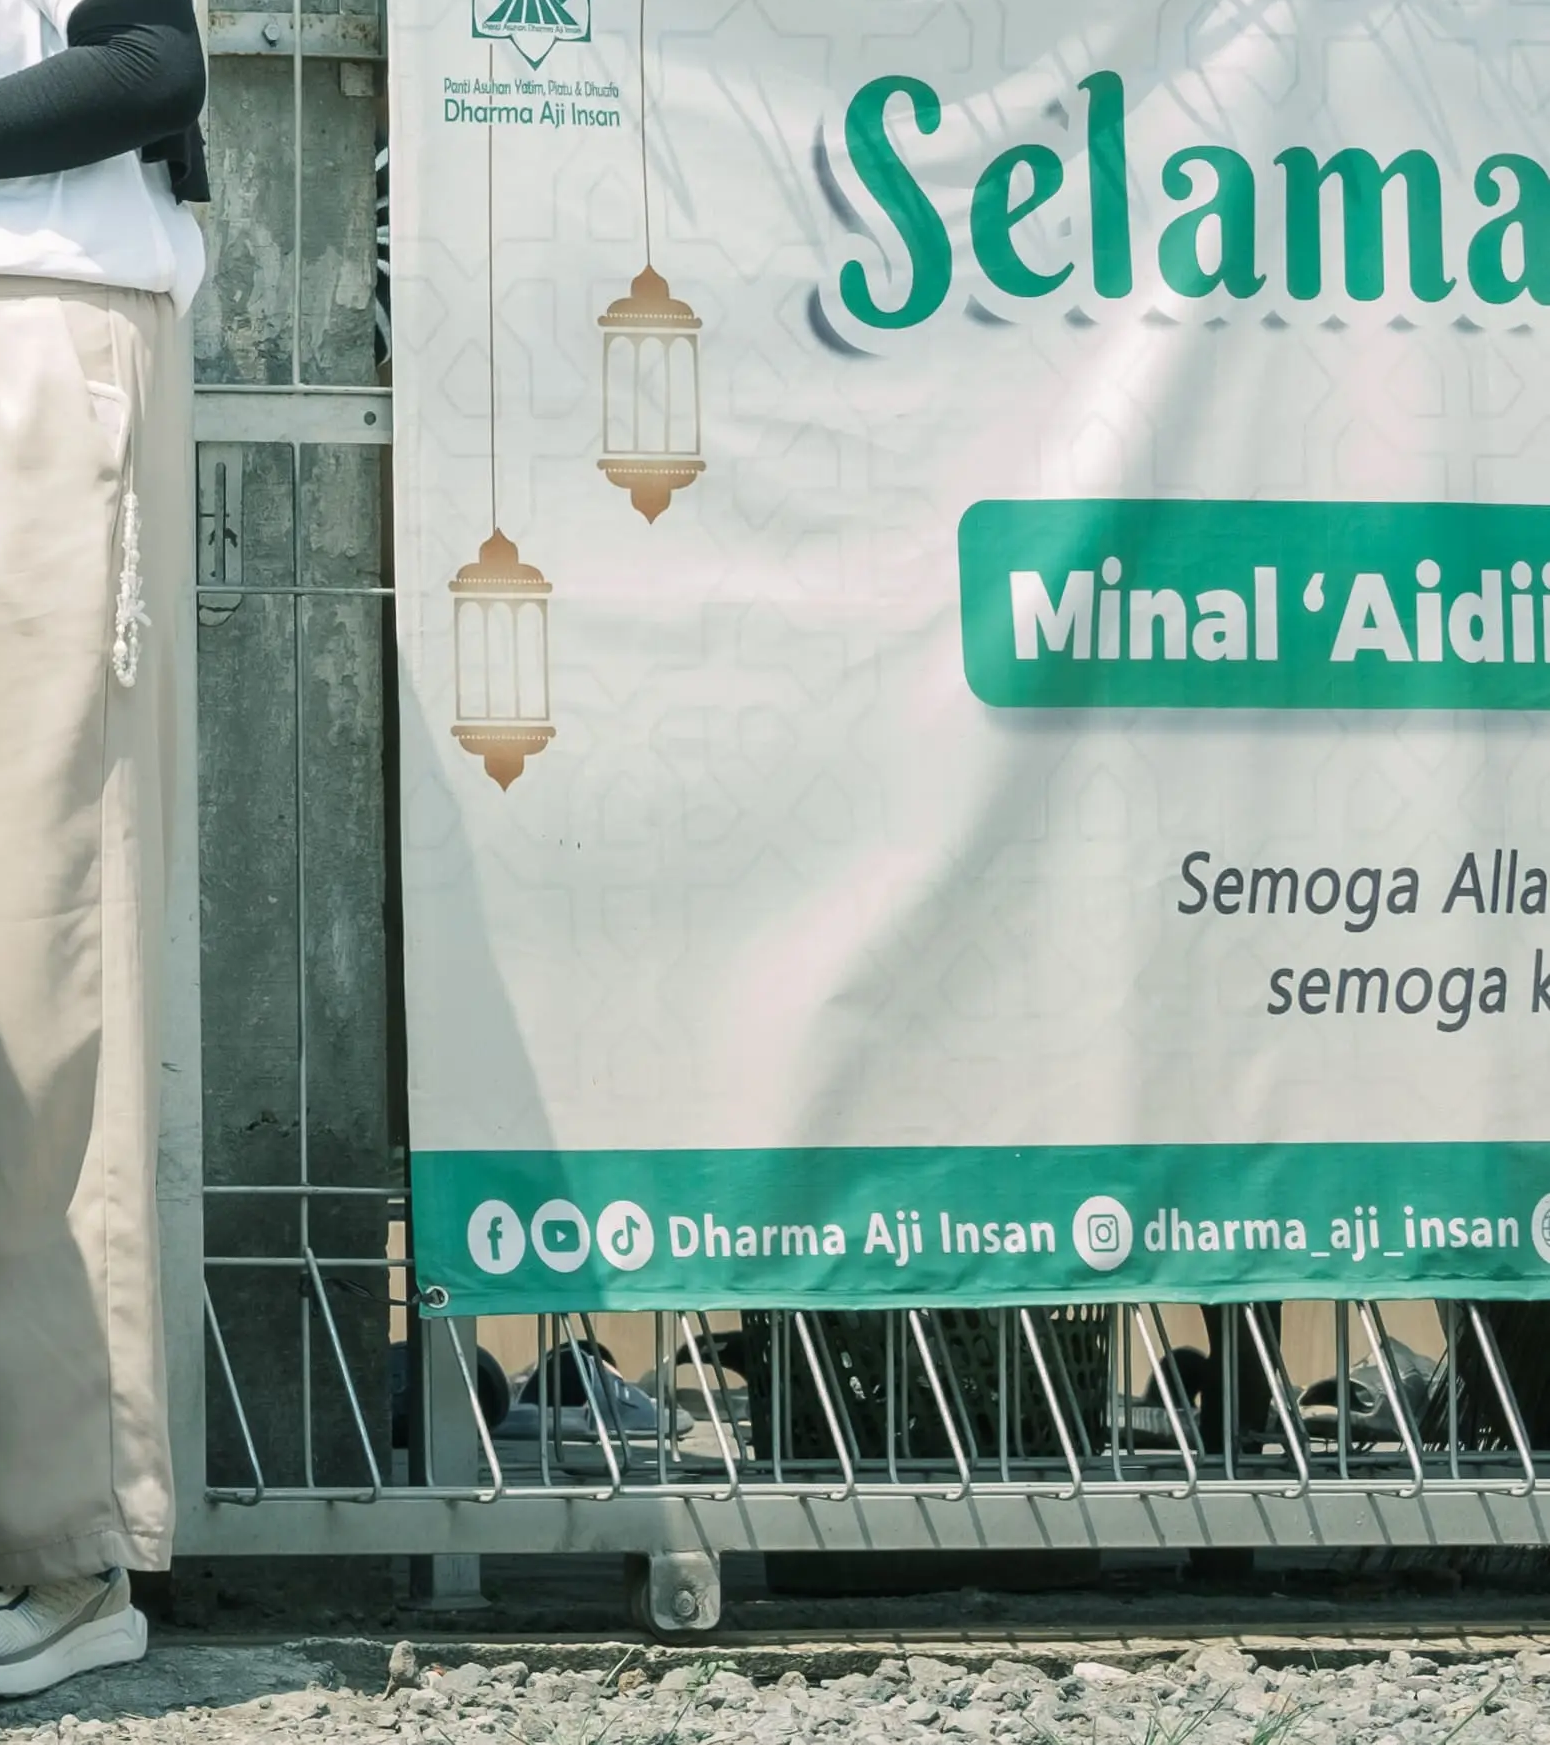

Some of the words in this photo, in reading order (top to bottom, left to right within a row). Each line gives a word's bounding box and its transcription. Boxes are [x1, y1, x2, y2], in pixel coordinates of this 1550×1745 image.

[444, 77, 471, 94] Panti
[473, 78, 511, 95] Asuhan
[548, 80, 572, 97] Piatu
[575, 83, 582, 97] &
[584, 81, 619, 98] Dhuafa
[444, 98, 533, 124] Dharma
[540, 100, 565, 128] Aji
[572, 102, 621, 127] Insan
[839, 70, 1550, 330] Selama
[1009, 557, 1277, 661] Minal
[1178, 851, 1418, 932] Semoga
[1442, 849, 1548, 914] Alla
[1267, 967, 1507, 1032] semoga
[669, 1213, 846, 1257] Dharma
[863, 1211, 922, 1266] Aji
[940, 1210, 1055, 1255] Insan
[1144, 1207, 1519, 1260] dharma_aji_insan
